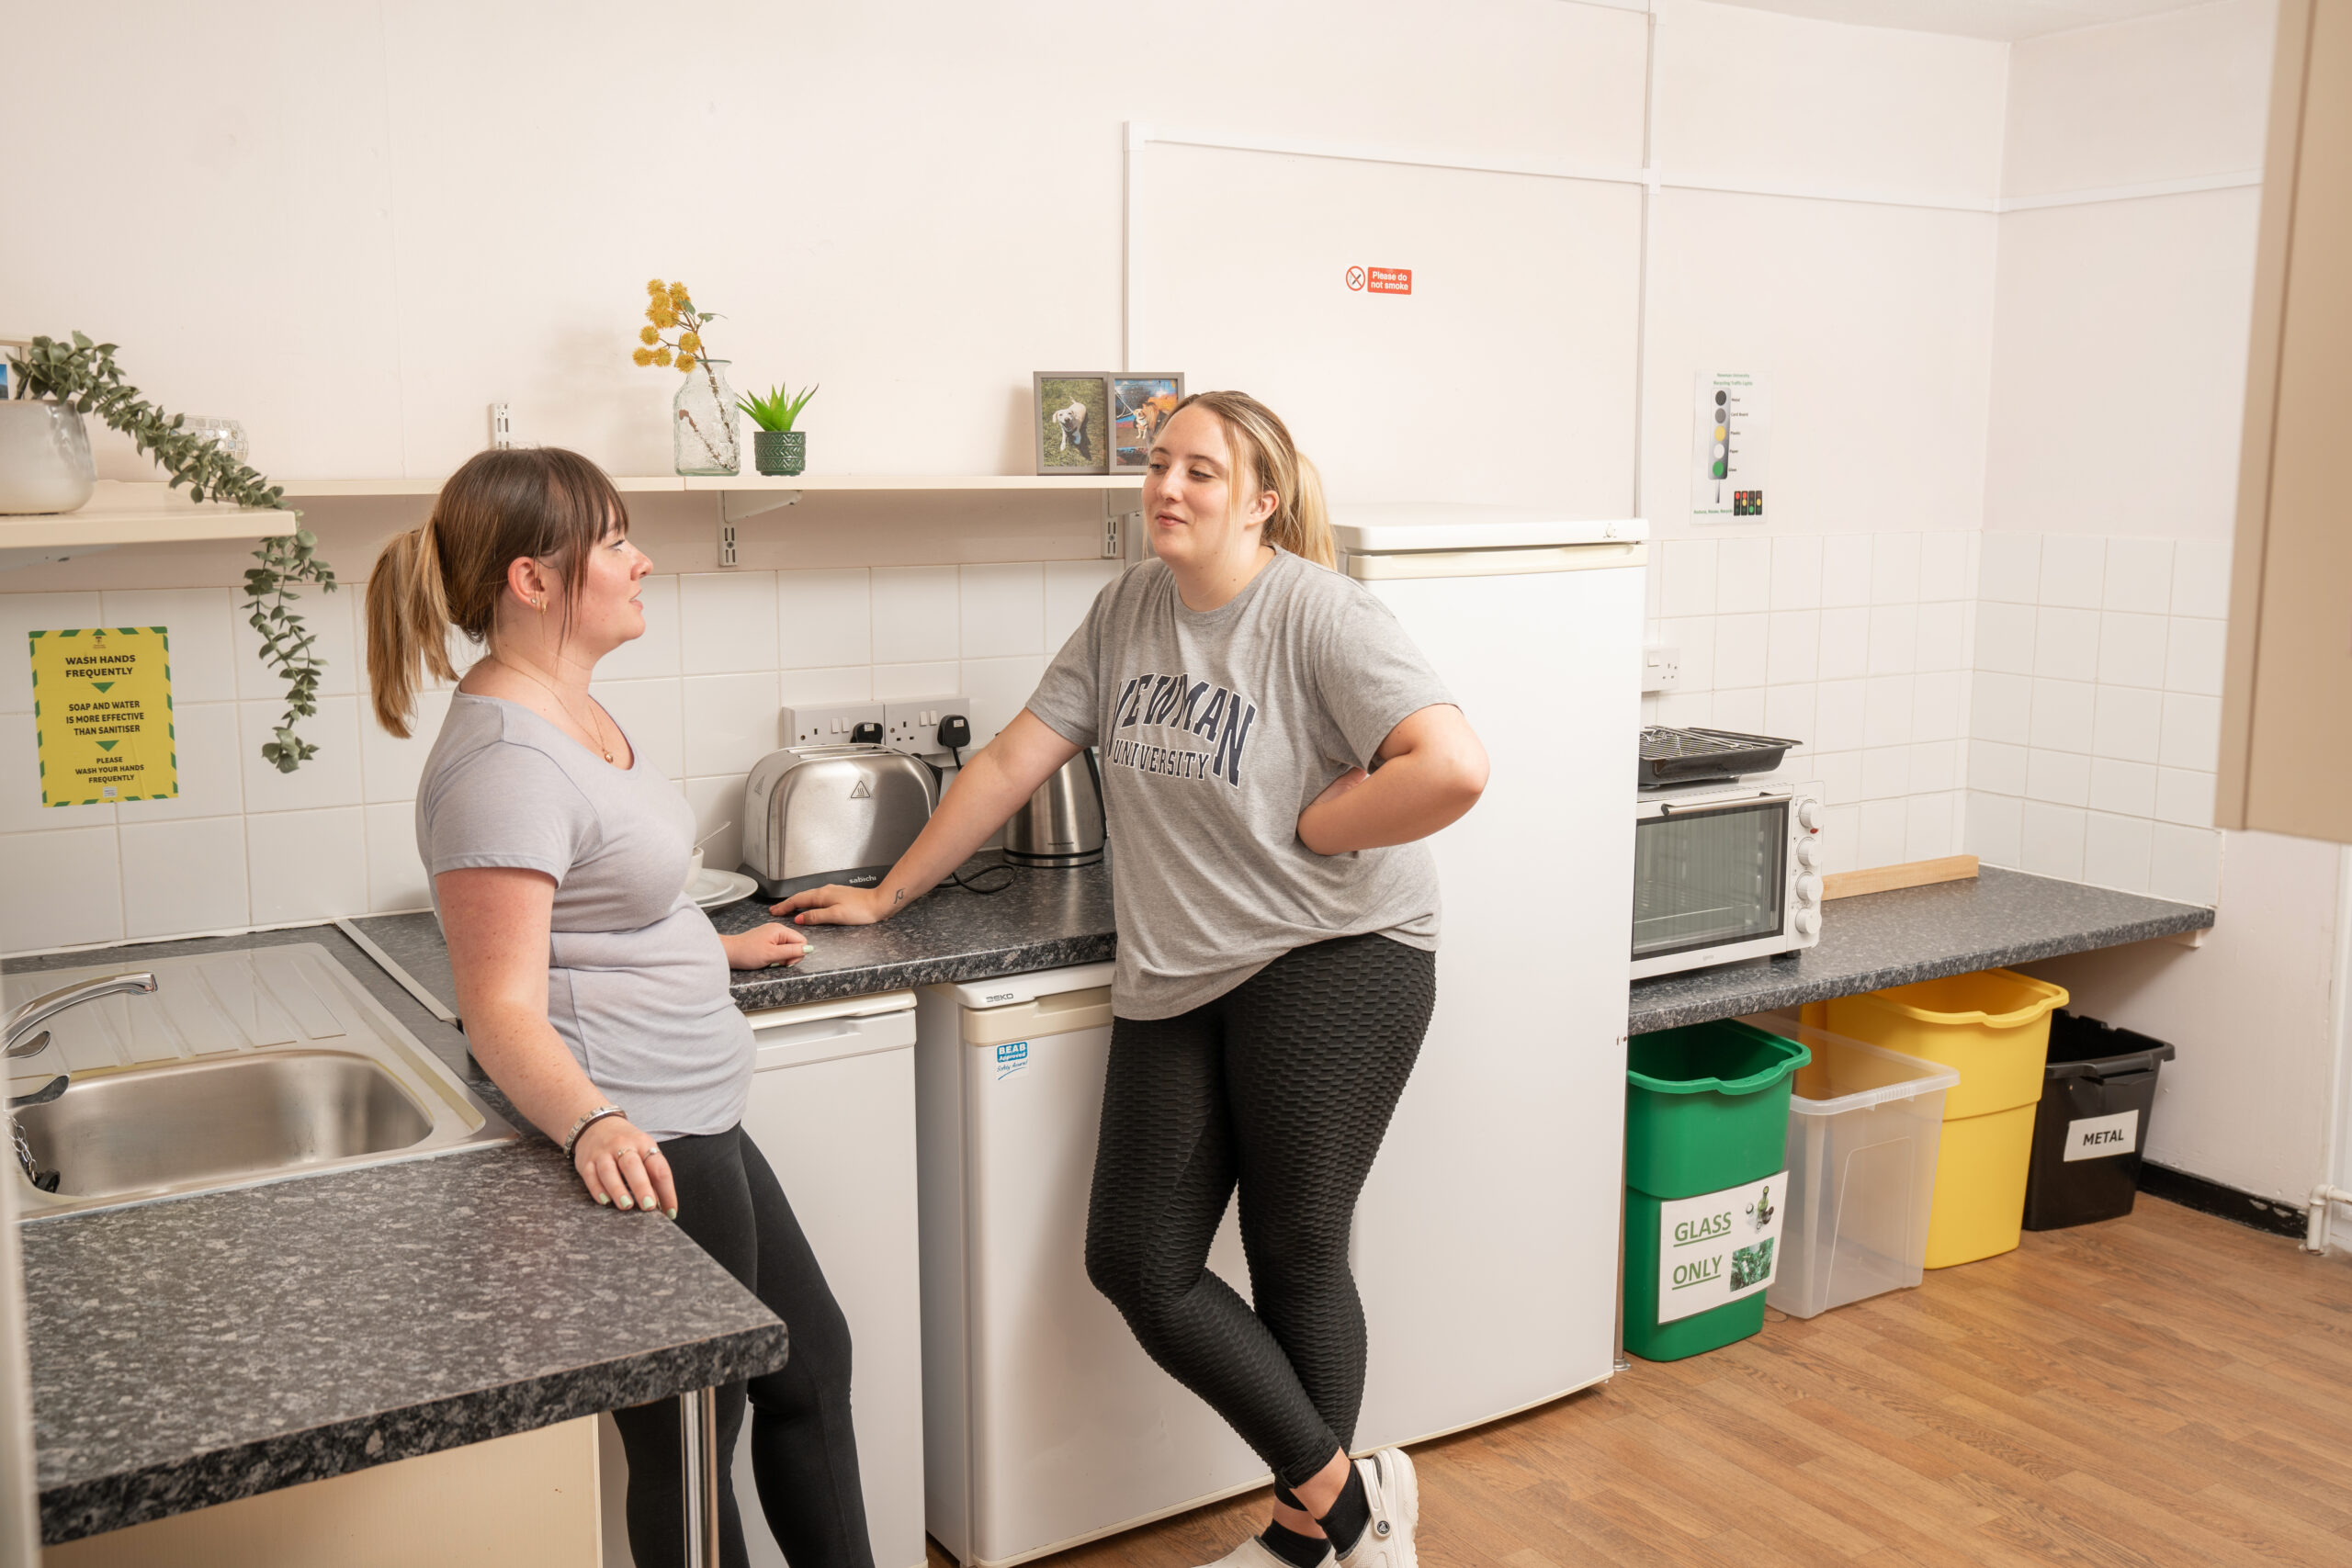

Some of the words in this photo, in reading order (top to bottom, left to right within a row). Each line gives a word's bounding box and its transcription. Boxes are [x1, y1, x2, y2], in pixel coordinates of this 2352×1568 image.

[1372, 271, 1396, 280] Please
[1397, 273, 1408, 281] do
[1371, 281, 1383, 289] not
[1385, 281, 1408, 290] smoke
[65, 656, 97, 665] WASH
[99, 654, 136, 663] HANDS
[65, 667, 133, 678] FREQUENTLY
[69, 703, 91, 711] SOAP
[93, 702, 110, 710] AND
[112, 700, 140, 709] WATER
[76, 715, 100, 723] MORE
[102, 712, 144, 722] EFFECTIVE
[74, 728, 96, 736] THAN
[98, 725, 141, 734] SANITISER
[96, 756, 123, 764] PLEASE
[1113, 739, 1211, 780] UNIVERSITY
[119, 764, 144, 773] HANDS
[88, 774, 134, 784] FREQUENTLY
[849, 874, 876, 884] sabichi
[999, 1043, 1026, 1055] BEAB
[999, 1052, 1026, 1062] Approved
[2083, 1129, 2124, 1145] METAL
[1674, 1212, 1732, 1241] GLASS
[1672, 1255, 1723, 1285] ONLY
